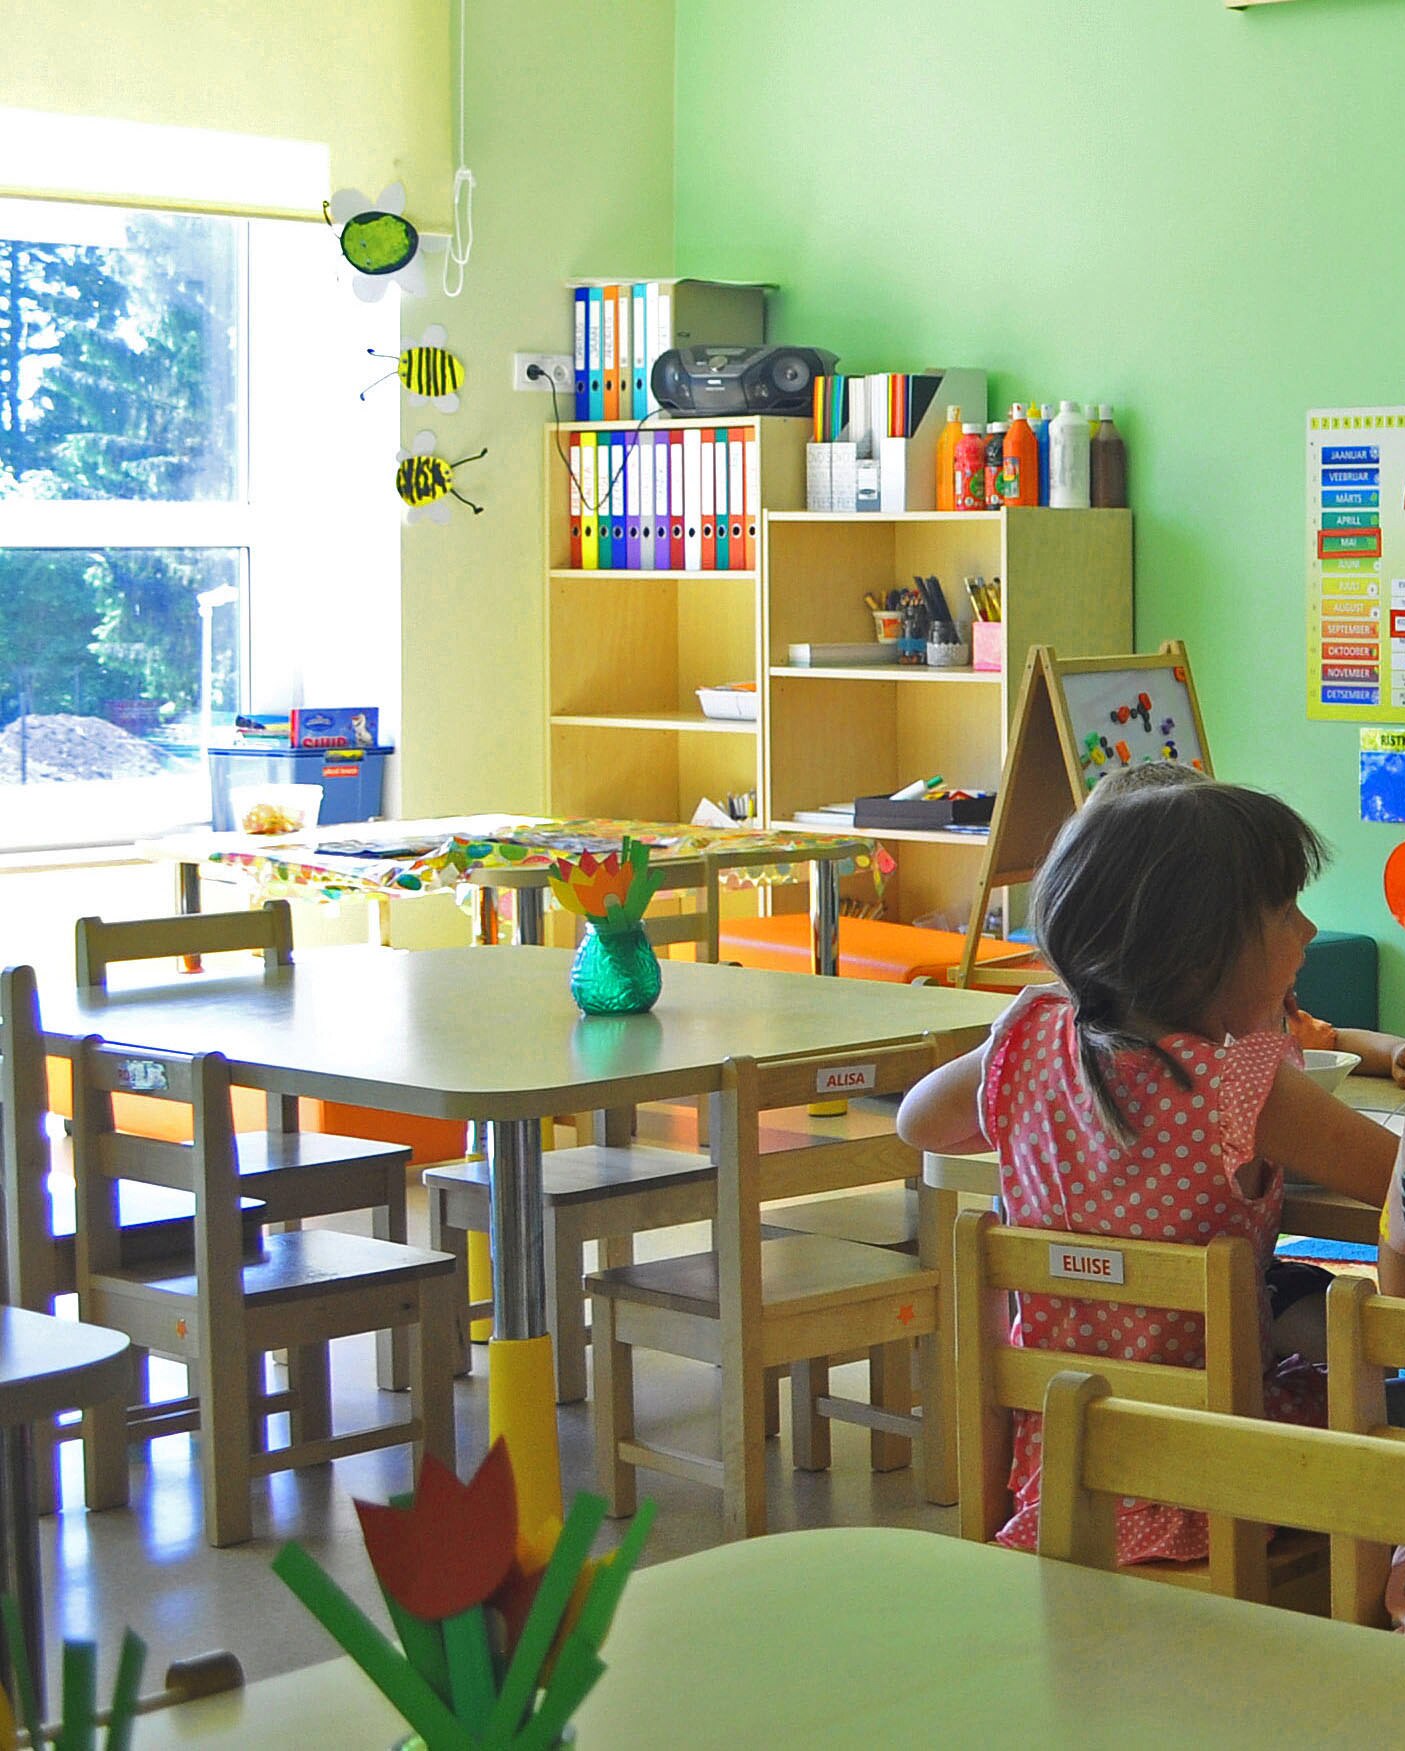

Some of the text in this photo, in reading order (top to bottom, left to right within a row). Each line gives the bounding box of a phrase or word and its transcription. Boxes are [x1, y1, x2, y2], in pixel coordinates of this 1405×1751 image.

[1331, 450, 1367, 460] JAANUAR
[1328, 471, 1369, 481] VEEBRUAR
[1336, 492, 1362, 503] MÄRTS
[1336, 516, 1361, 525] APRILL
[1340, 538, 1357, 546] MAI
[1334, 603, 1364, 612] AUGUST
[1328, 624, 1370, 634] SEPTEMBER
[1328, 646, 1370, 656] OKTOOBER
[1327, 668, 1370, 678] NOVEMBER
[1326, 689, 1370, 699] DETSEMBER
[826, 1072, 866, 1087] ALISA
[1063, 1255, 1112, 1276] ELIISE
